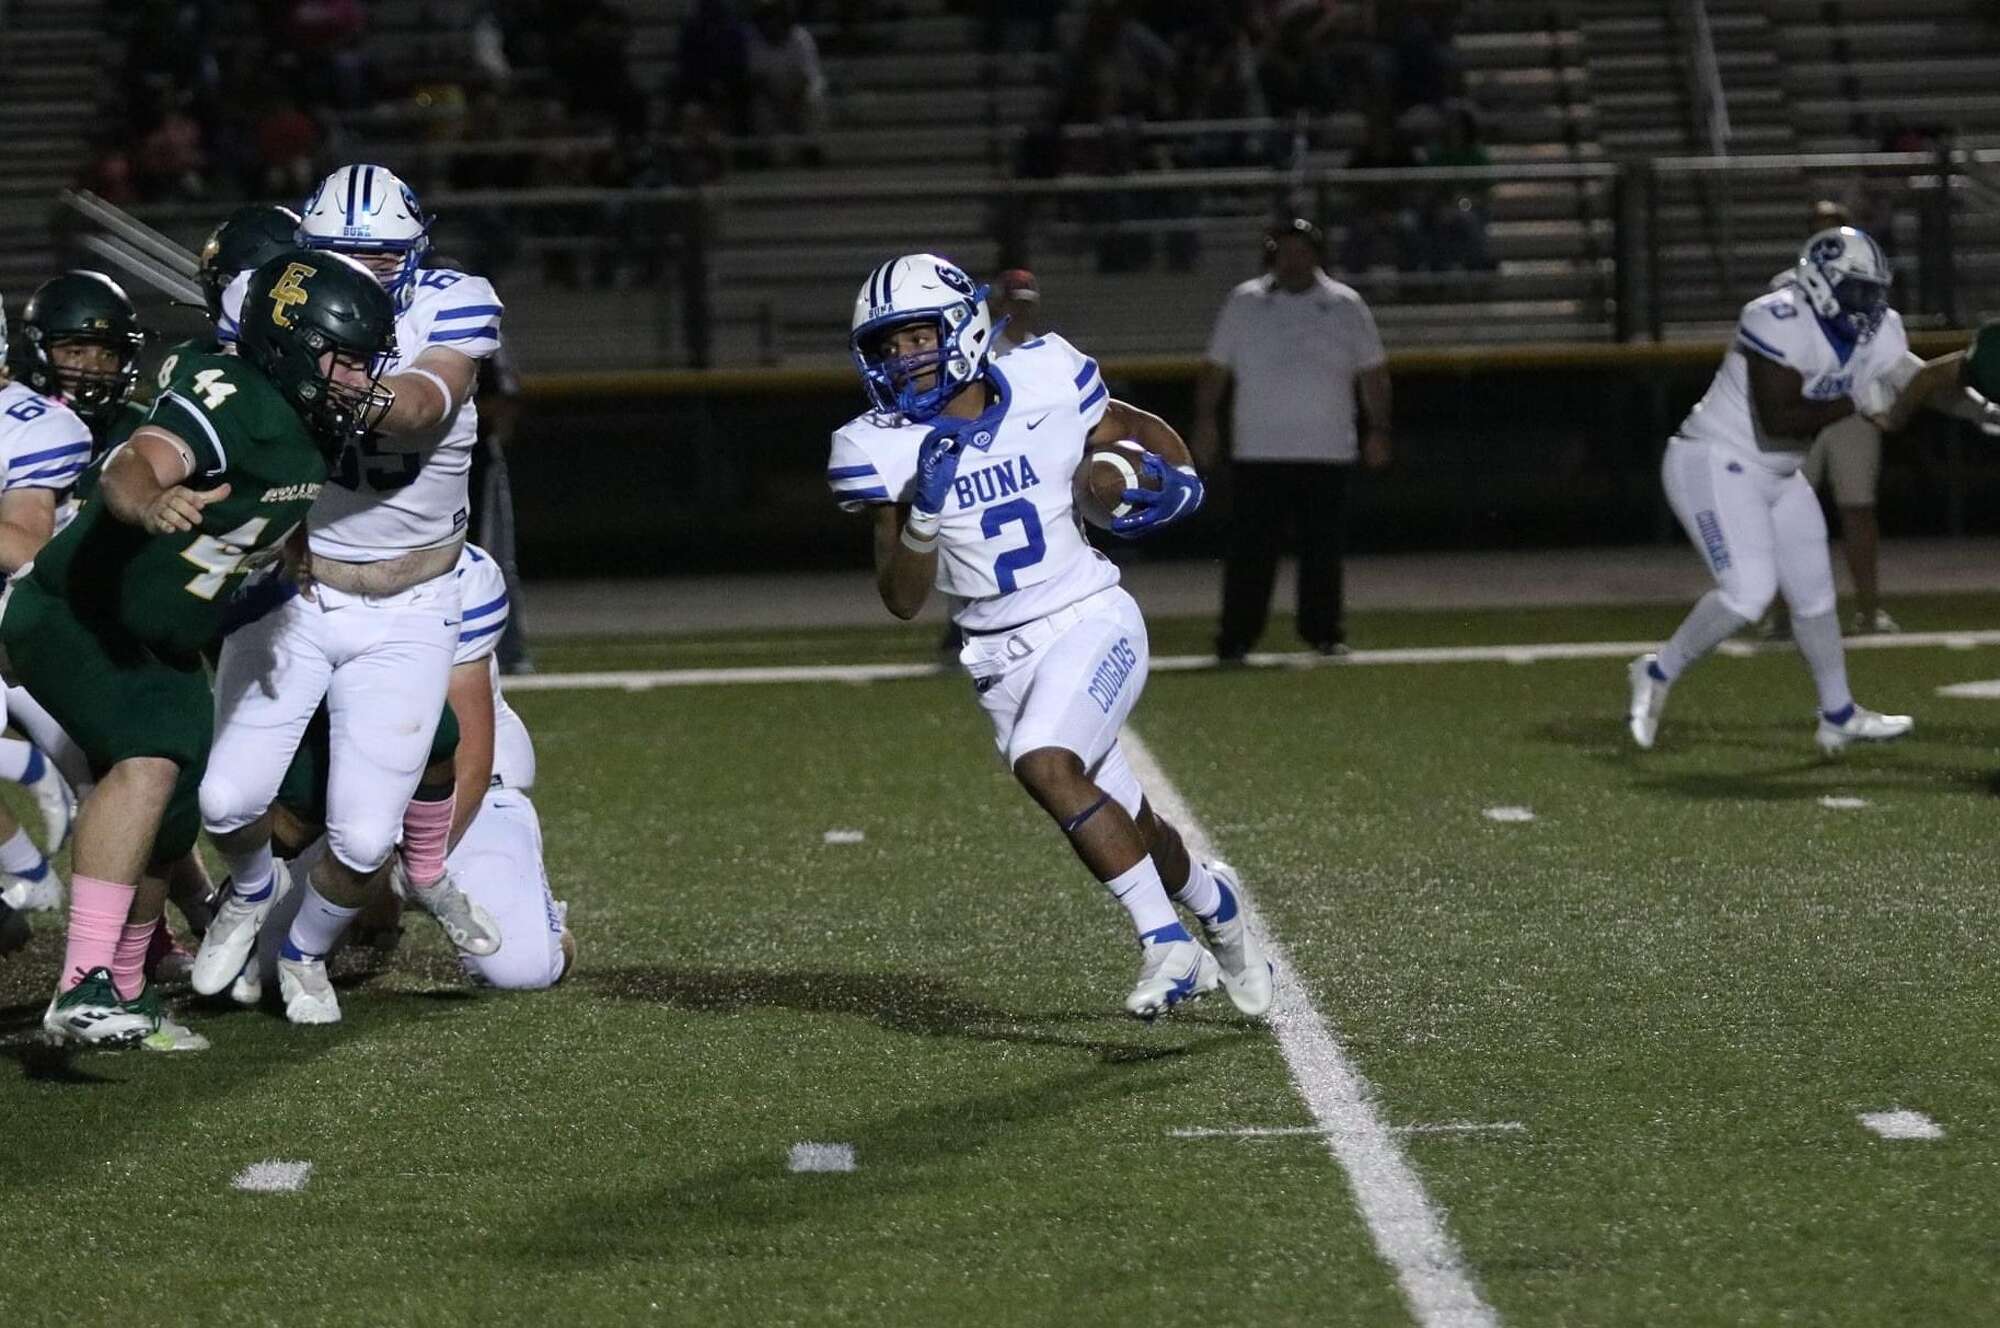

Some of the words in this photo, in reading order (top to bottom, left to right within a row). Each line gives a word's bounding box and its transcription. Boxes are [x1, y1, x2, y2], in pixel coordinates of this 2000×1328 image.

[955, 454, 1041, 510] BUNA
[980, 497, 1046, 594] 2
[1088, 637, 1136, 713] COUGARS
